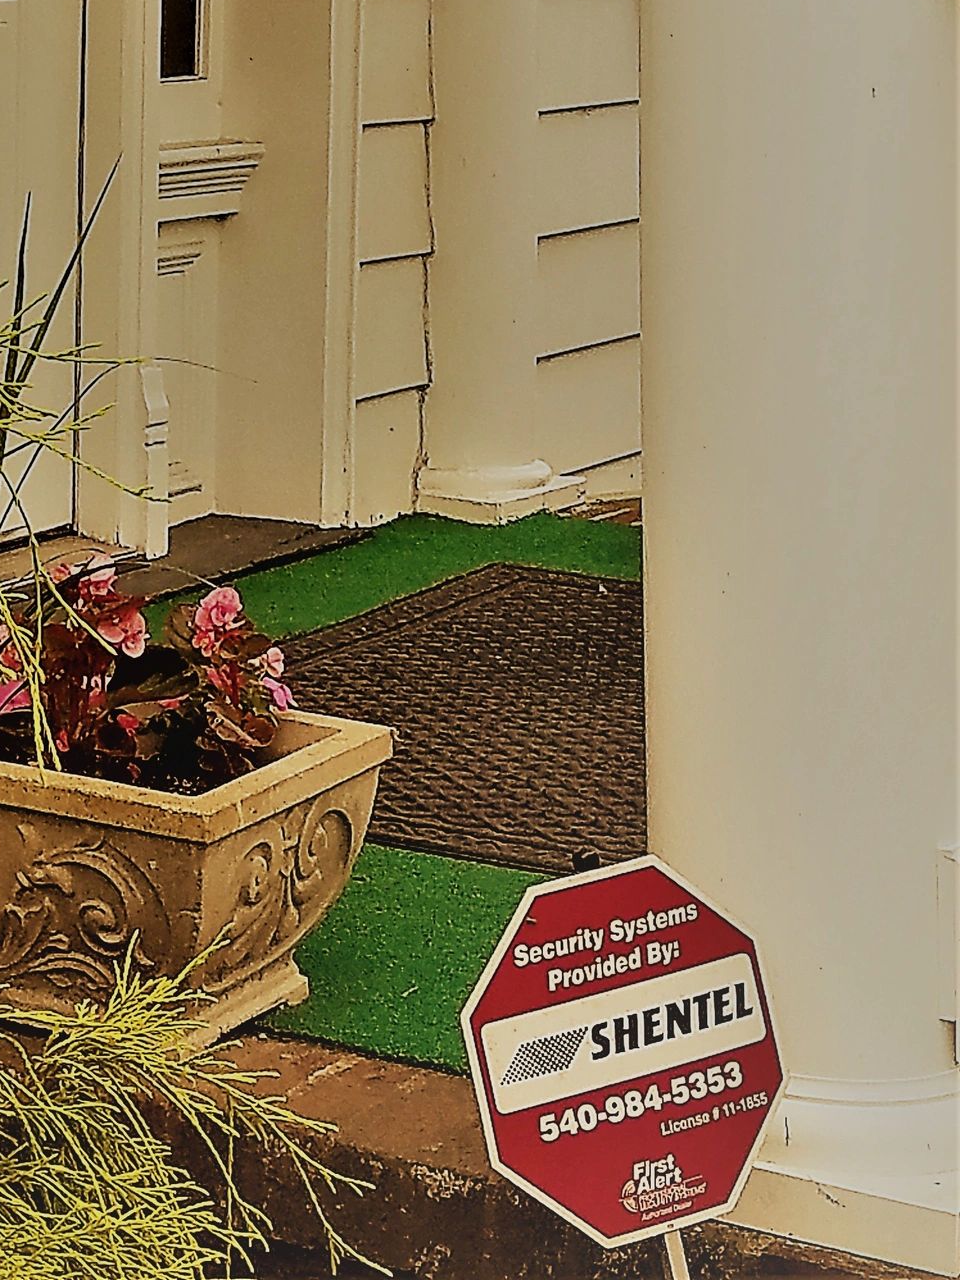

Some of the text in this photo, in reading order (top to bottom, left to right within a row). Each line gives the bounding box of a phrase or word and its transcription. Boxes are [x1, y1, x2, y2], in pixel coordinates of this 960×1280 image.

[513, 903, 699, 968] Security Systems
[547, 939, 681, 992] Provided By:
[591, 982, 754, 1061] SHENTEL
[539, 1060, 743, 1142] 540-984-5353
[660, 1112, 710, 1136] License
[722, 1091, 769, 1118] 11-1855
[633, 1153, 675, 1181] First
[637, 1166, 683, 1196] Alert
